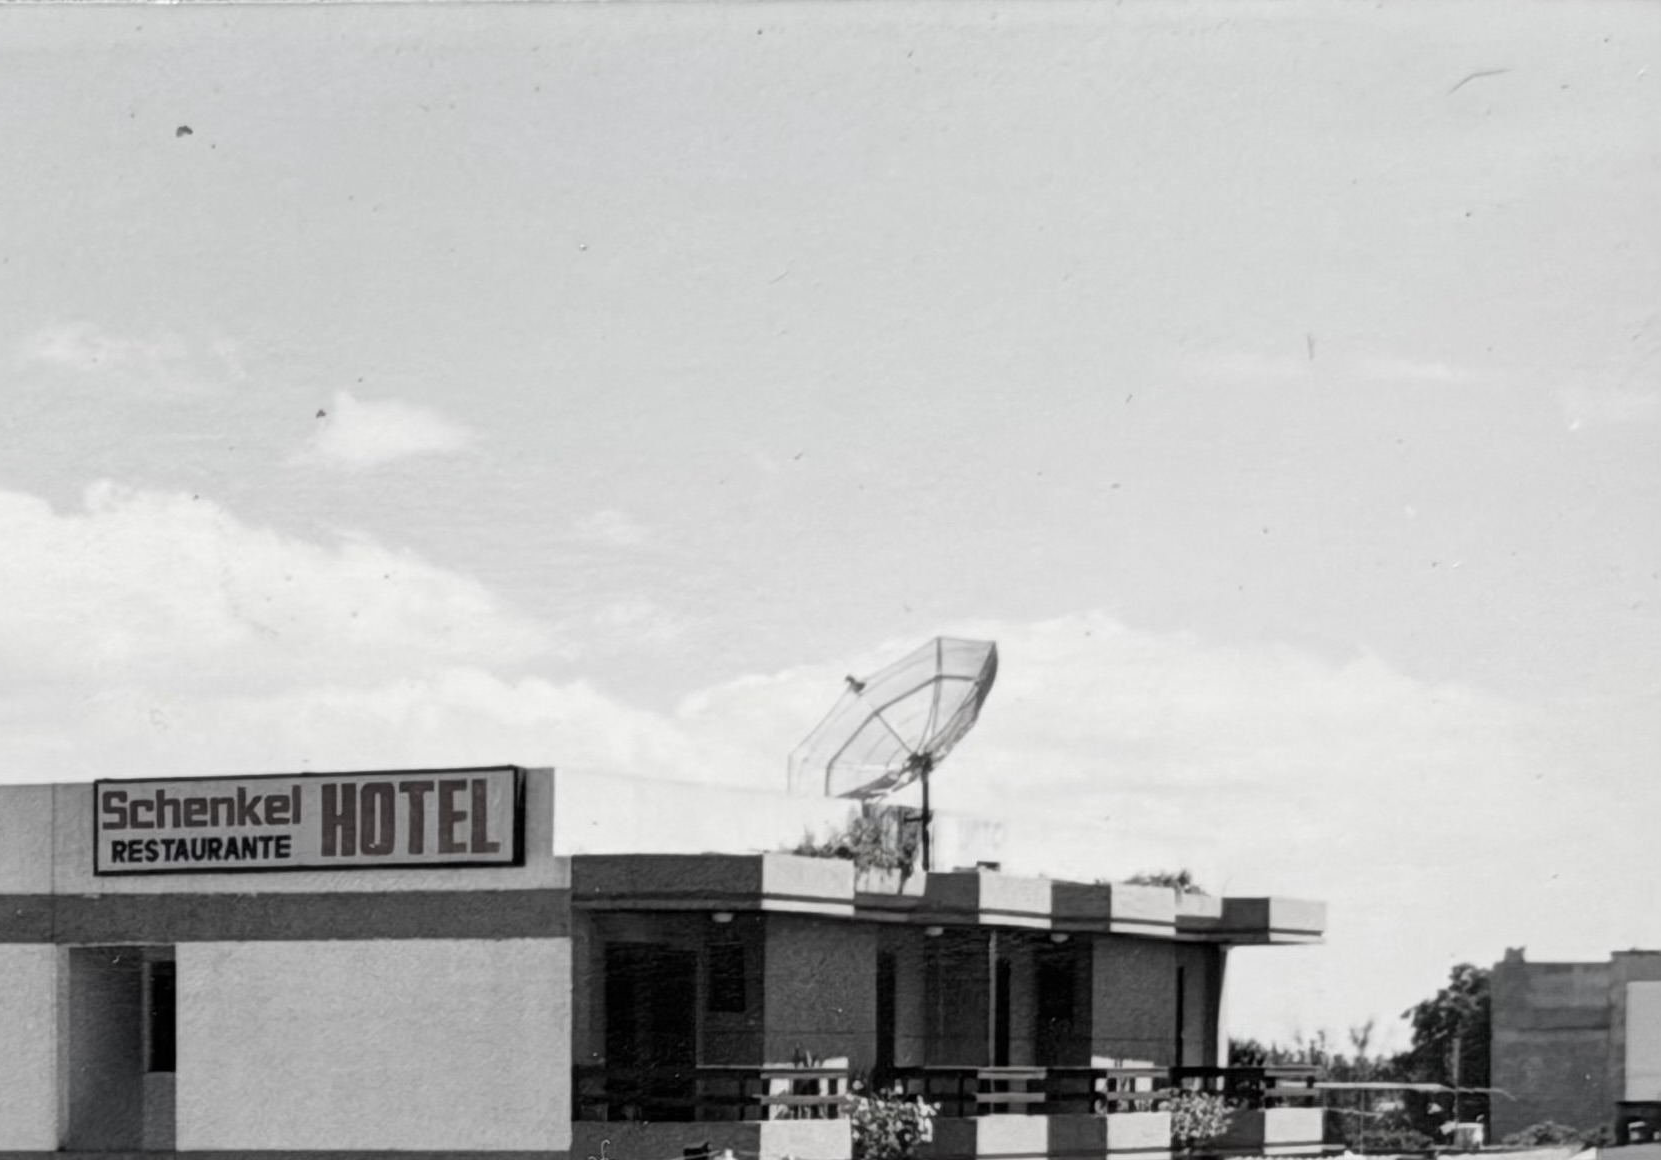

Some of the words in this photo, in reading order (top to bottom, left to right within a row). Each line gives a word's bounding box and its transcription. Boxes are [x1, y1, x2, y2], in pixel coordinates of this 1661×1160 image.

[102, 784, 302, 829] Schenkel
[320, 779, 501, 857] HOTEL
[111, 834, 292, 863] RESTAURANTE
